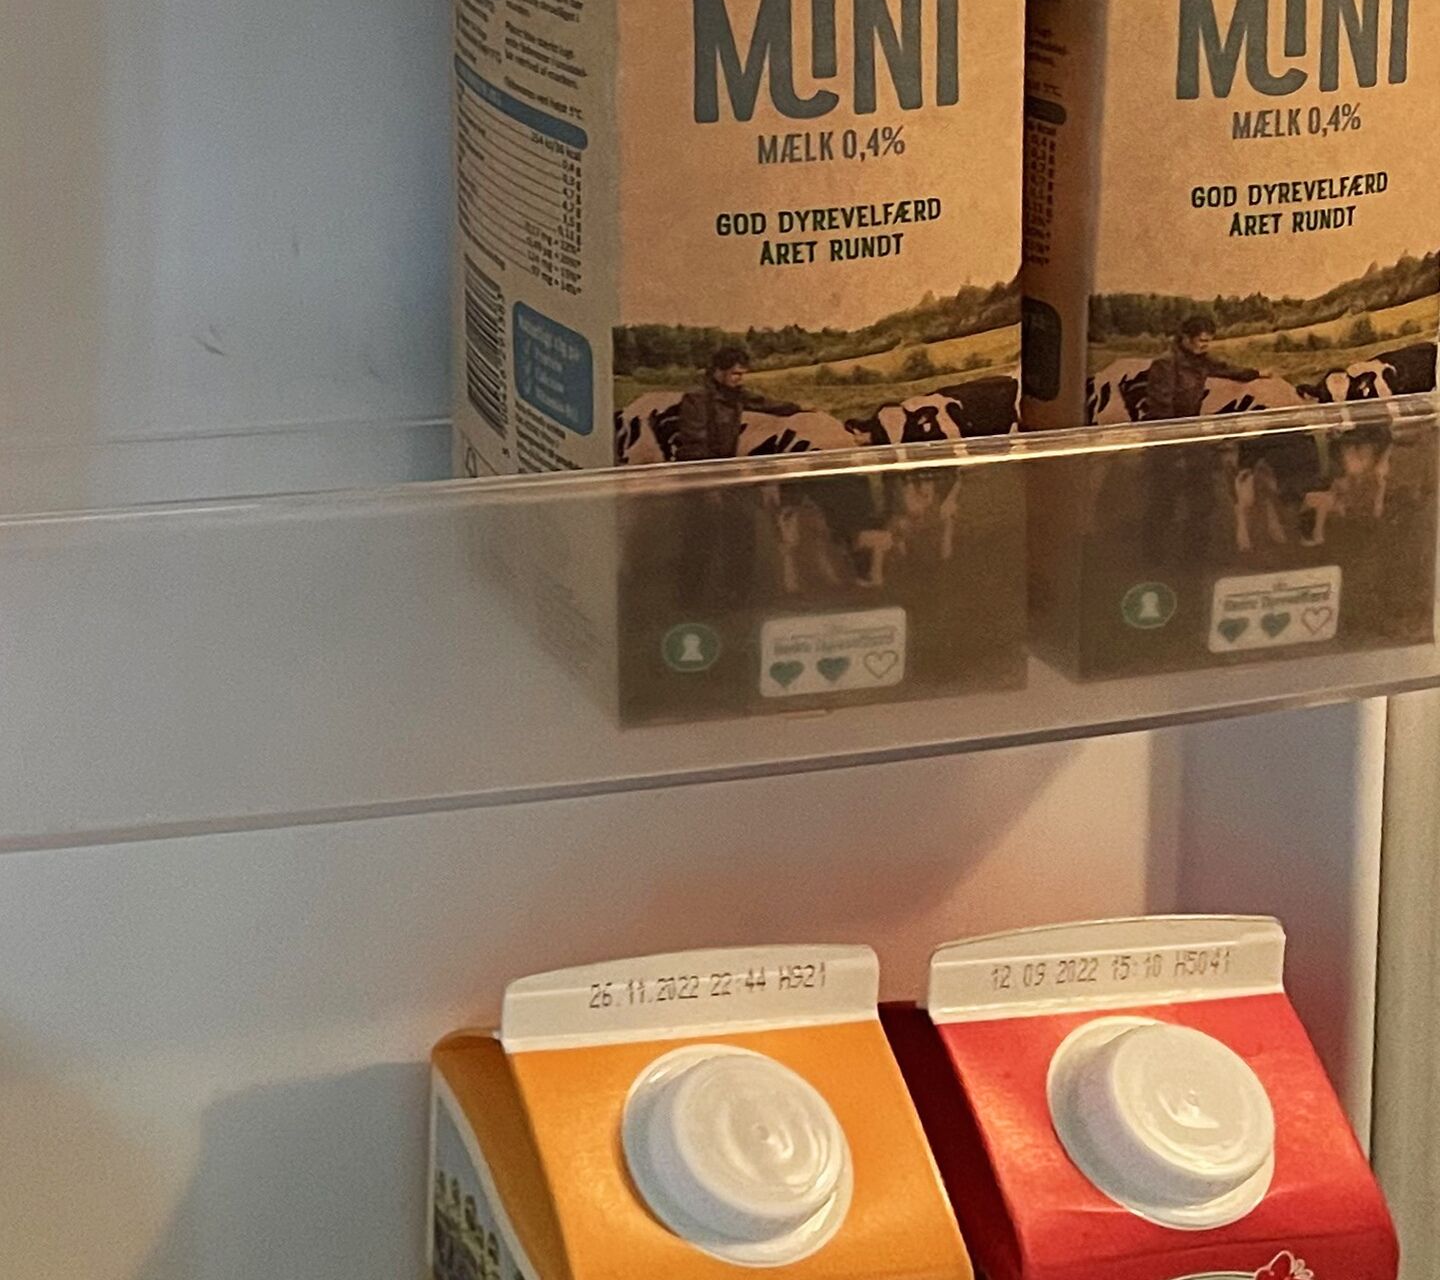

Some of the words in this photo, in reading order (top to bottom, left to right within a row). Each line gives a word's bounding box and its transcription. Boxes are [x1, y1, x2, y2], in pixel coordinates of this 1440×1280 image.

[1232, 109, 1301, 140] MÆLK
[1308, 102, 1362, 138] 0,4%
[758, 129, 834, 165] MÆLK
[842, 125, 906, 161] 0,4%
[1191, 185, 1238, 209] GOD
[1247, 171, 1388, 207] DYREVELFÆRD
[716, 212, 767, 236] GOD
[778, 197, 941, 235] DYREVELFÆRD
[1292, 205, 1357, 234] RUNDT
[830, 232, 904, 262] RUNDT
